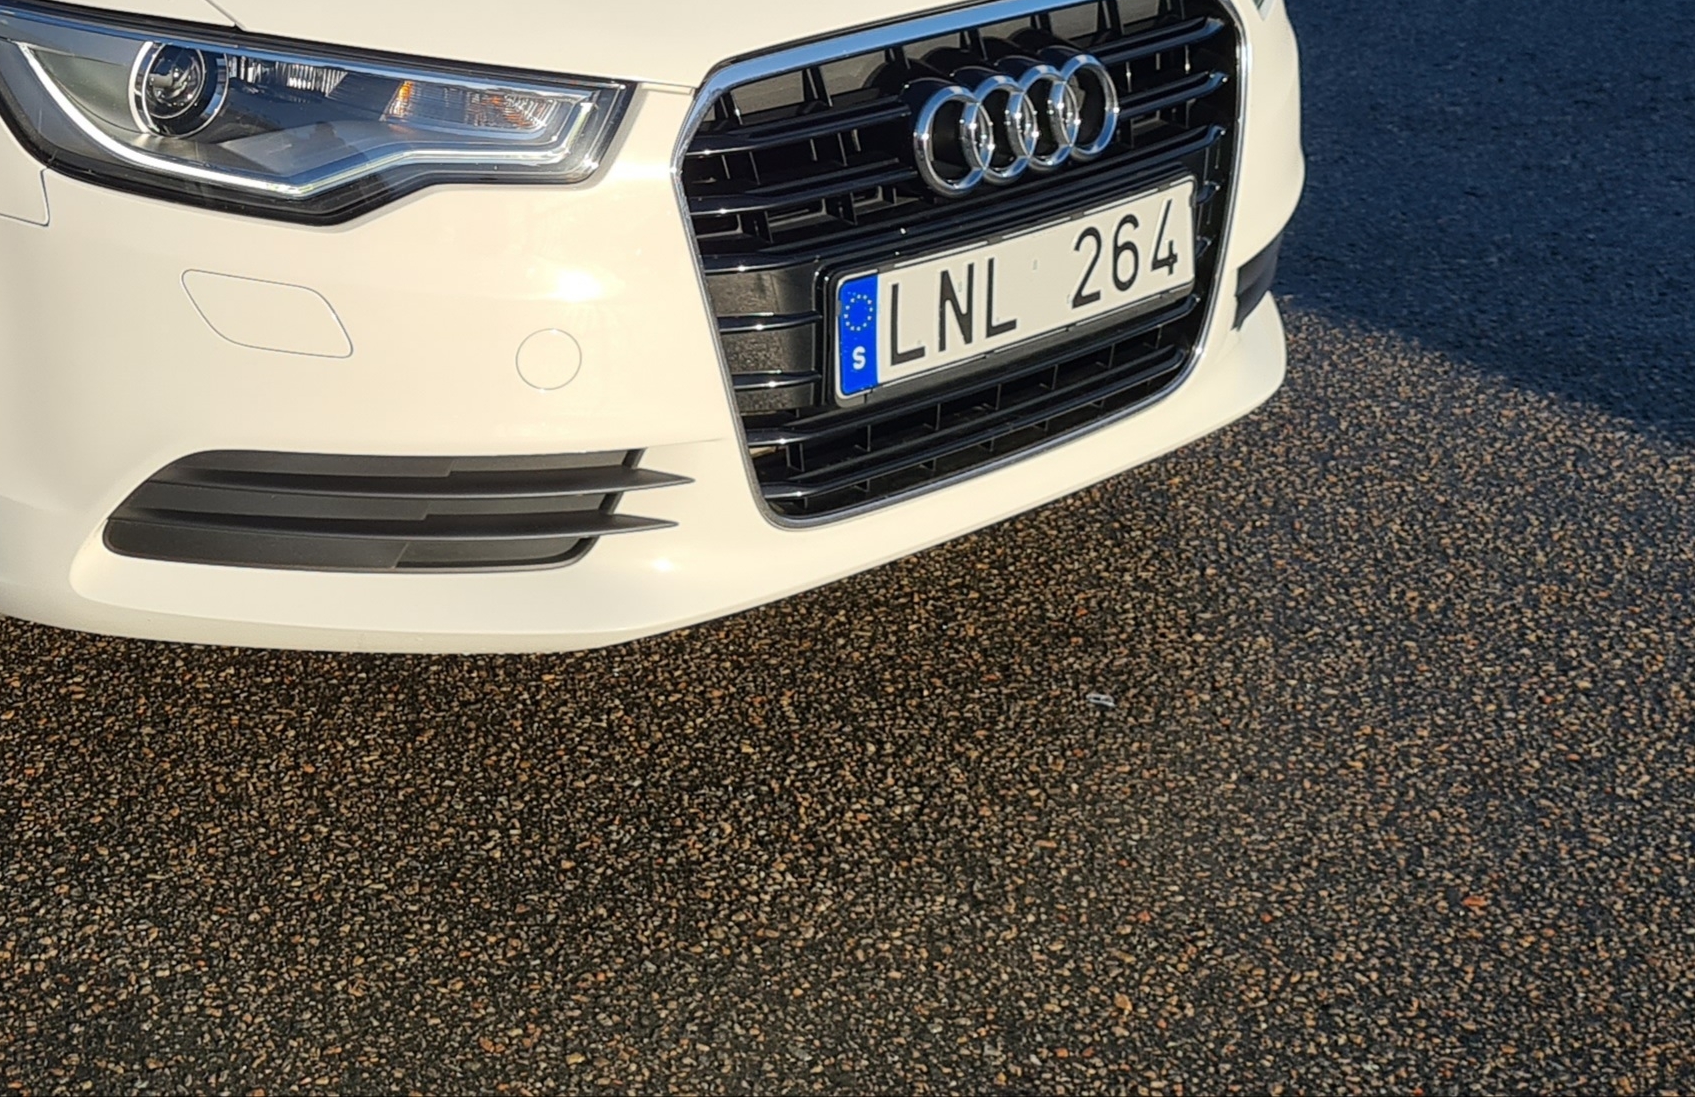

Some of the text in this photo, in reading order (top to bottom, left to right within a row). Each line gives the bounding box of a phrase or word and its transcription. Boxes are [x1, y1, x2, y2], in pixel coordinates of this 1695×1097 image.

[889, 198, 1179, 366] LNL 264
[852, 346, 866, 370] S
